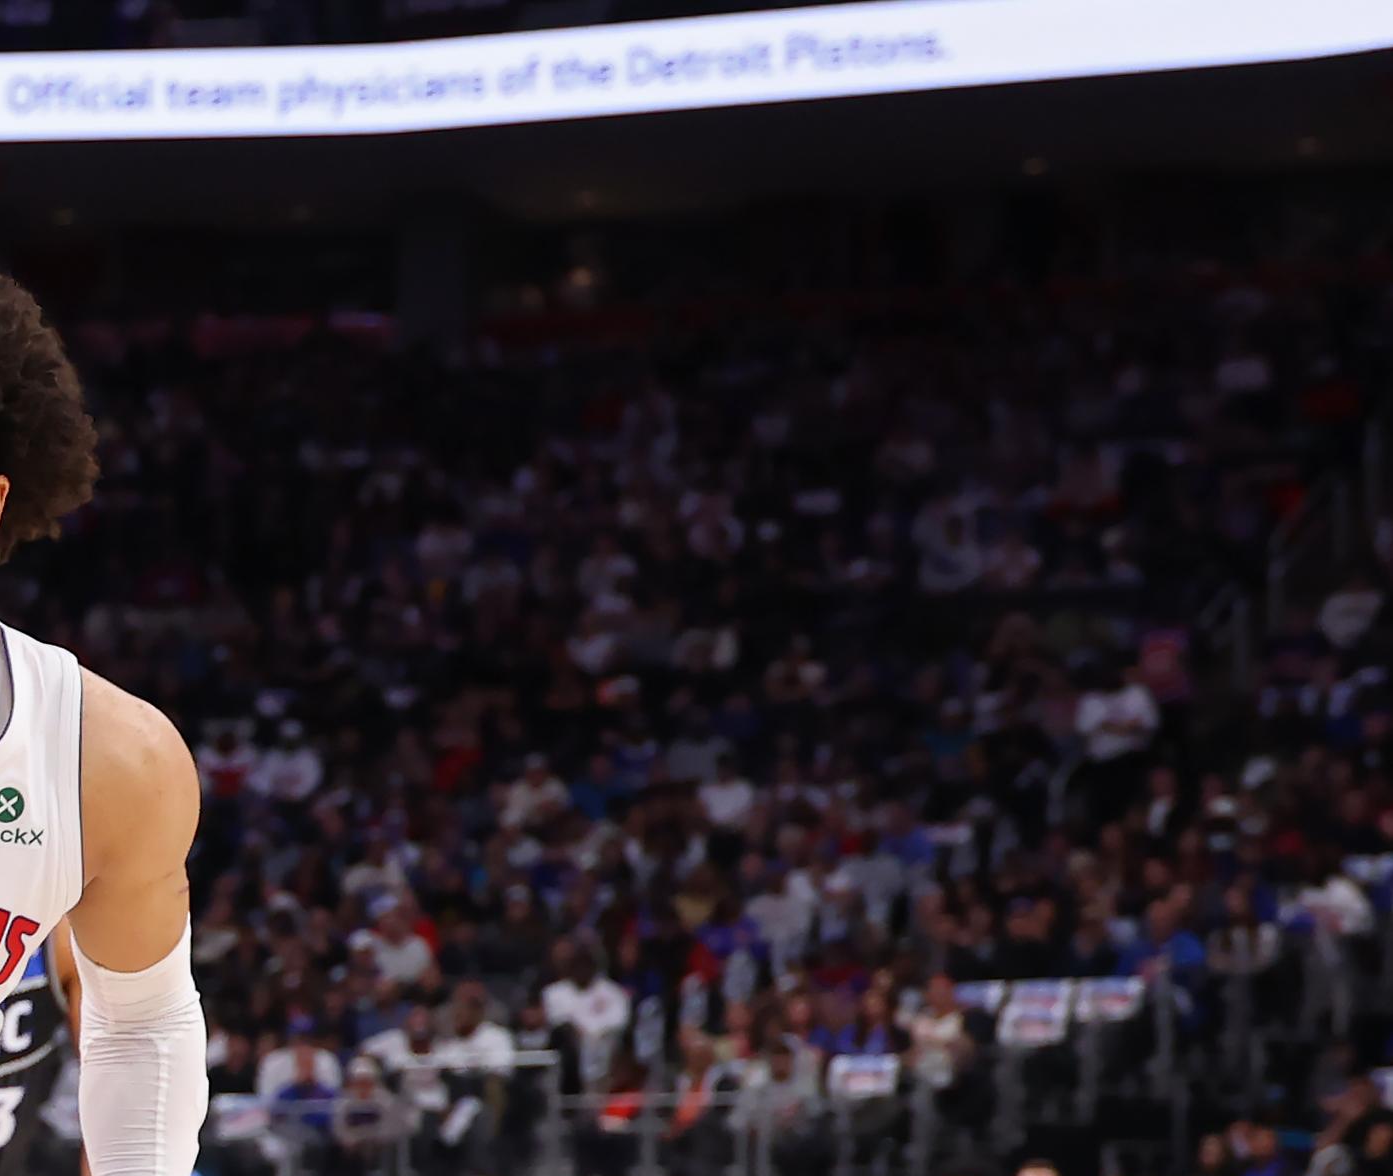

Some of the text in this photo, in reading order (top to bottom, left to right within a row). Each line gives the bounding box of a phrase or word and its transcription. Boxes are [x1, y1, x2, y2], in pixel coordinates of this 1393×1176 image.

[7, 30, 950, 122] Official team physicians of the Detroit Pistons.
